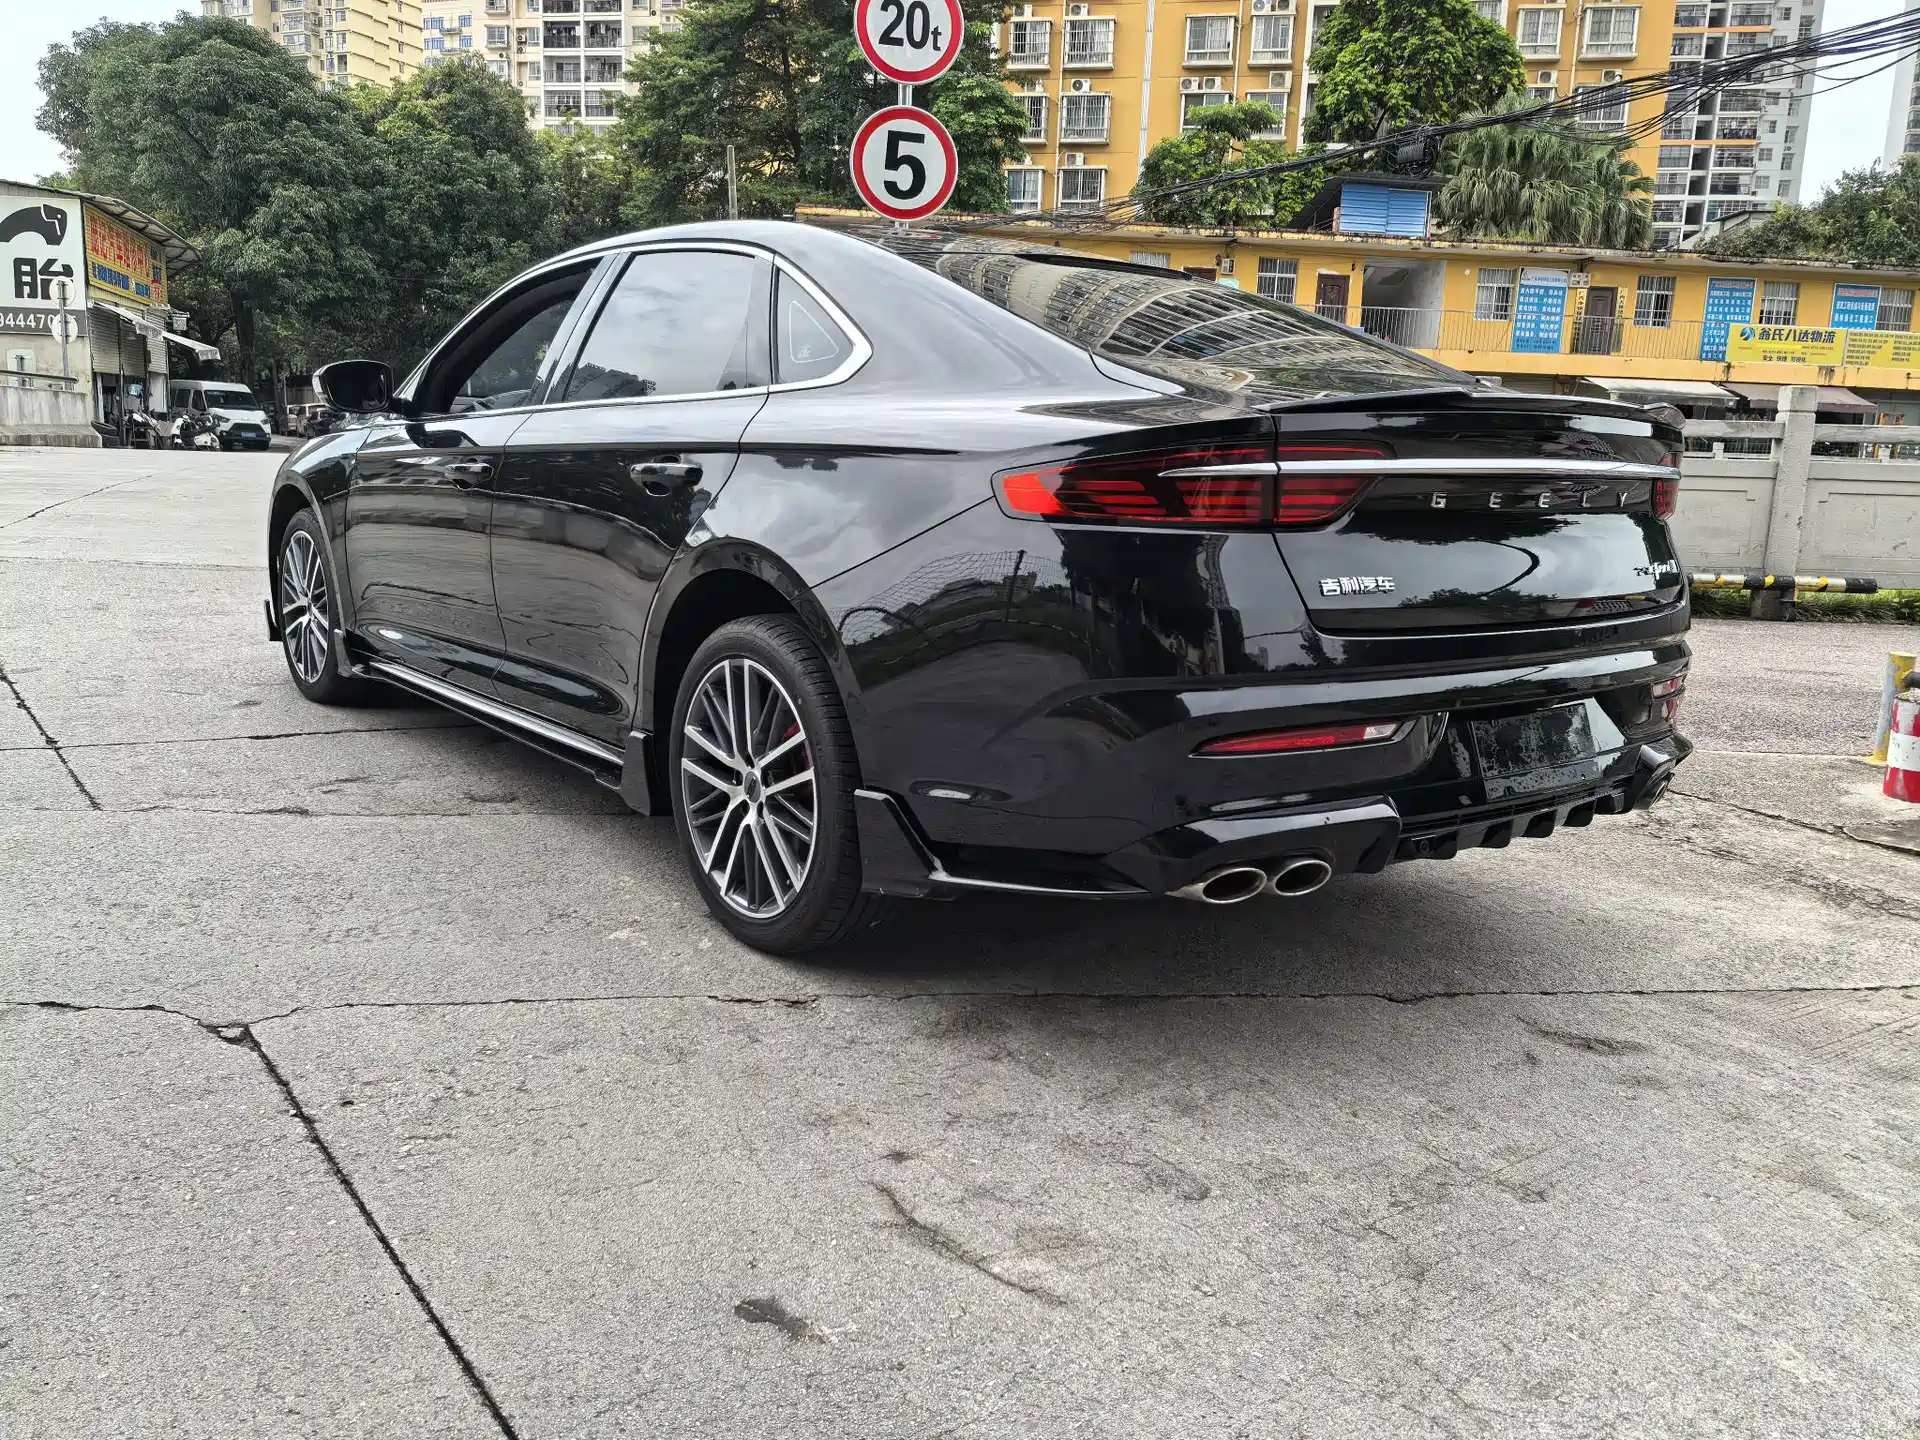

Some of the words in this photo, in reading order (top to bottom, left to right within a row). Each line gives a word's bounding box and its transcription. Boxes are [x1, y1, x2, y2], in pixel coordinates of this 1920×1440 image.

[878, 0, 942, 51] 20t
[883, 129, 927, 200] 5
[13, 257, 74, 300] 胎
[0, 312, 76, 329] 44470
[1758, 327, 1836, 344] 翁氏八达物流
[1430, 491, 1628, 508] GEELY
[1319, 576, 1395, 596] 吉利汽车
